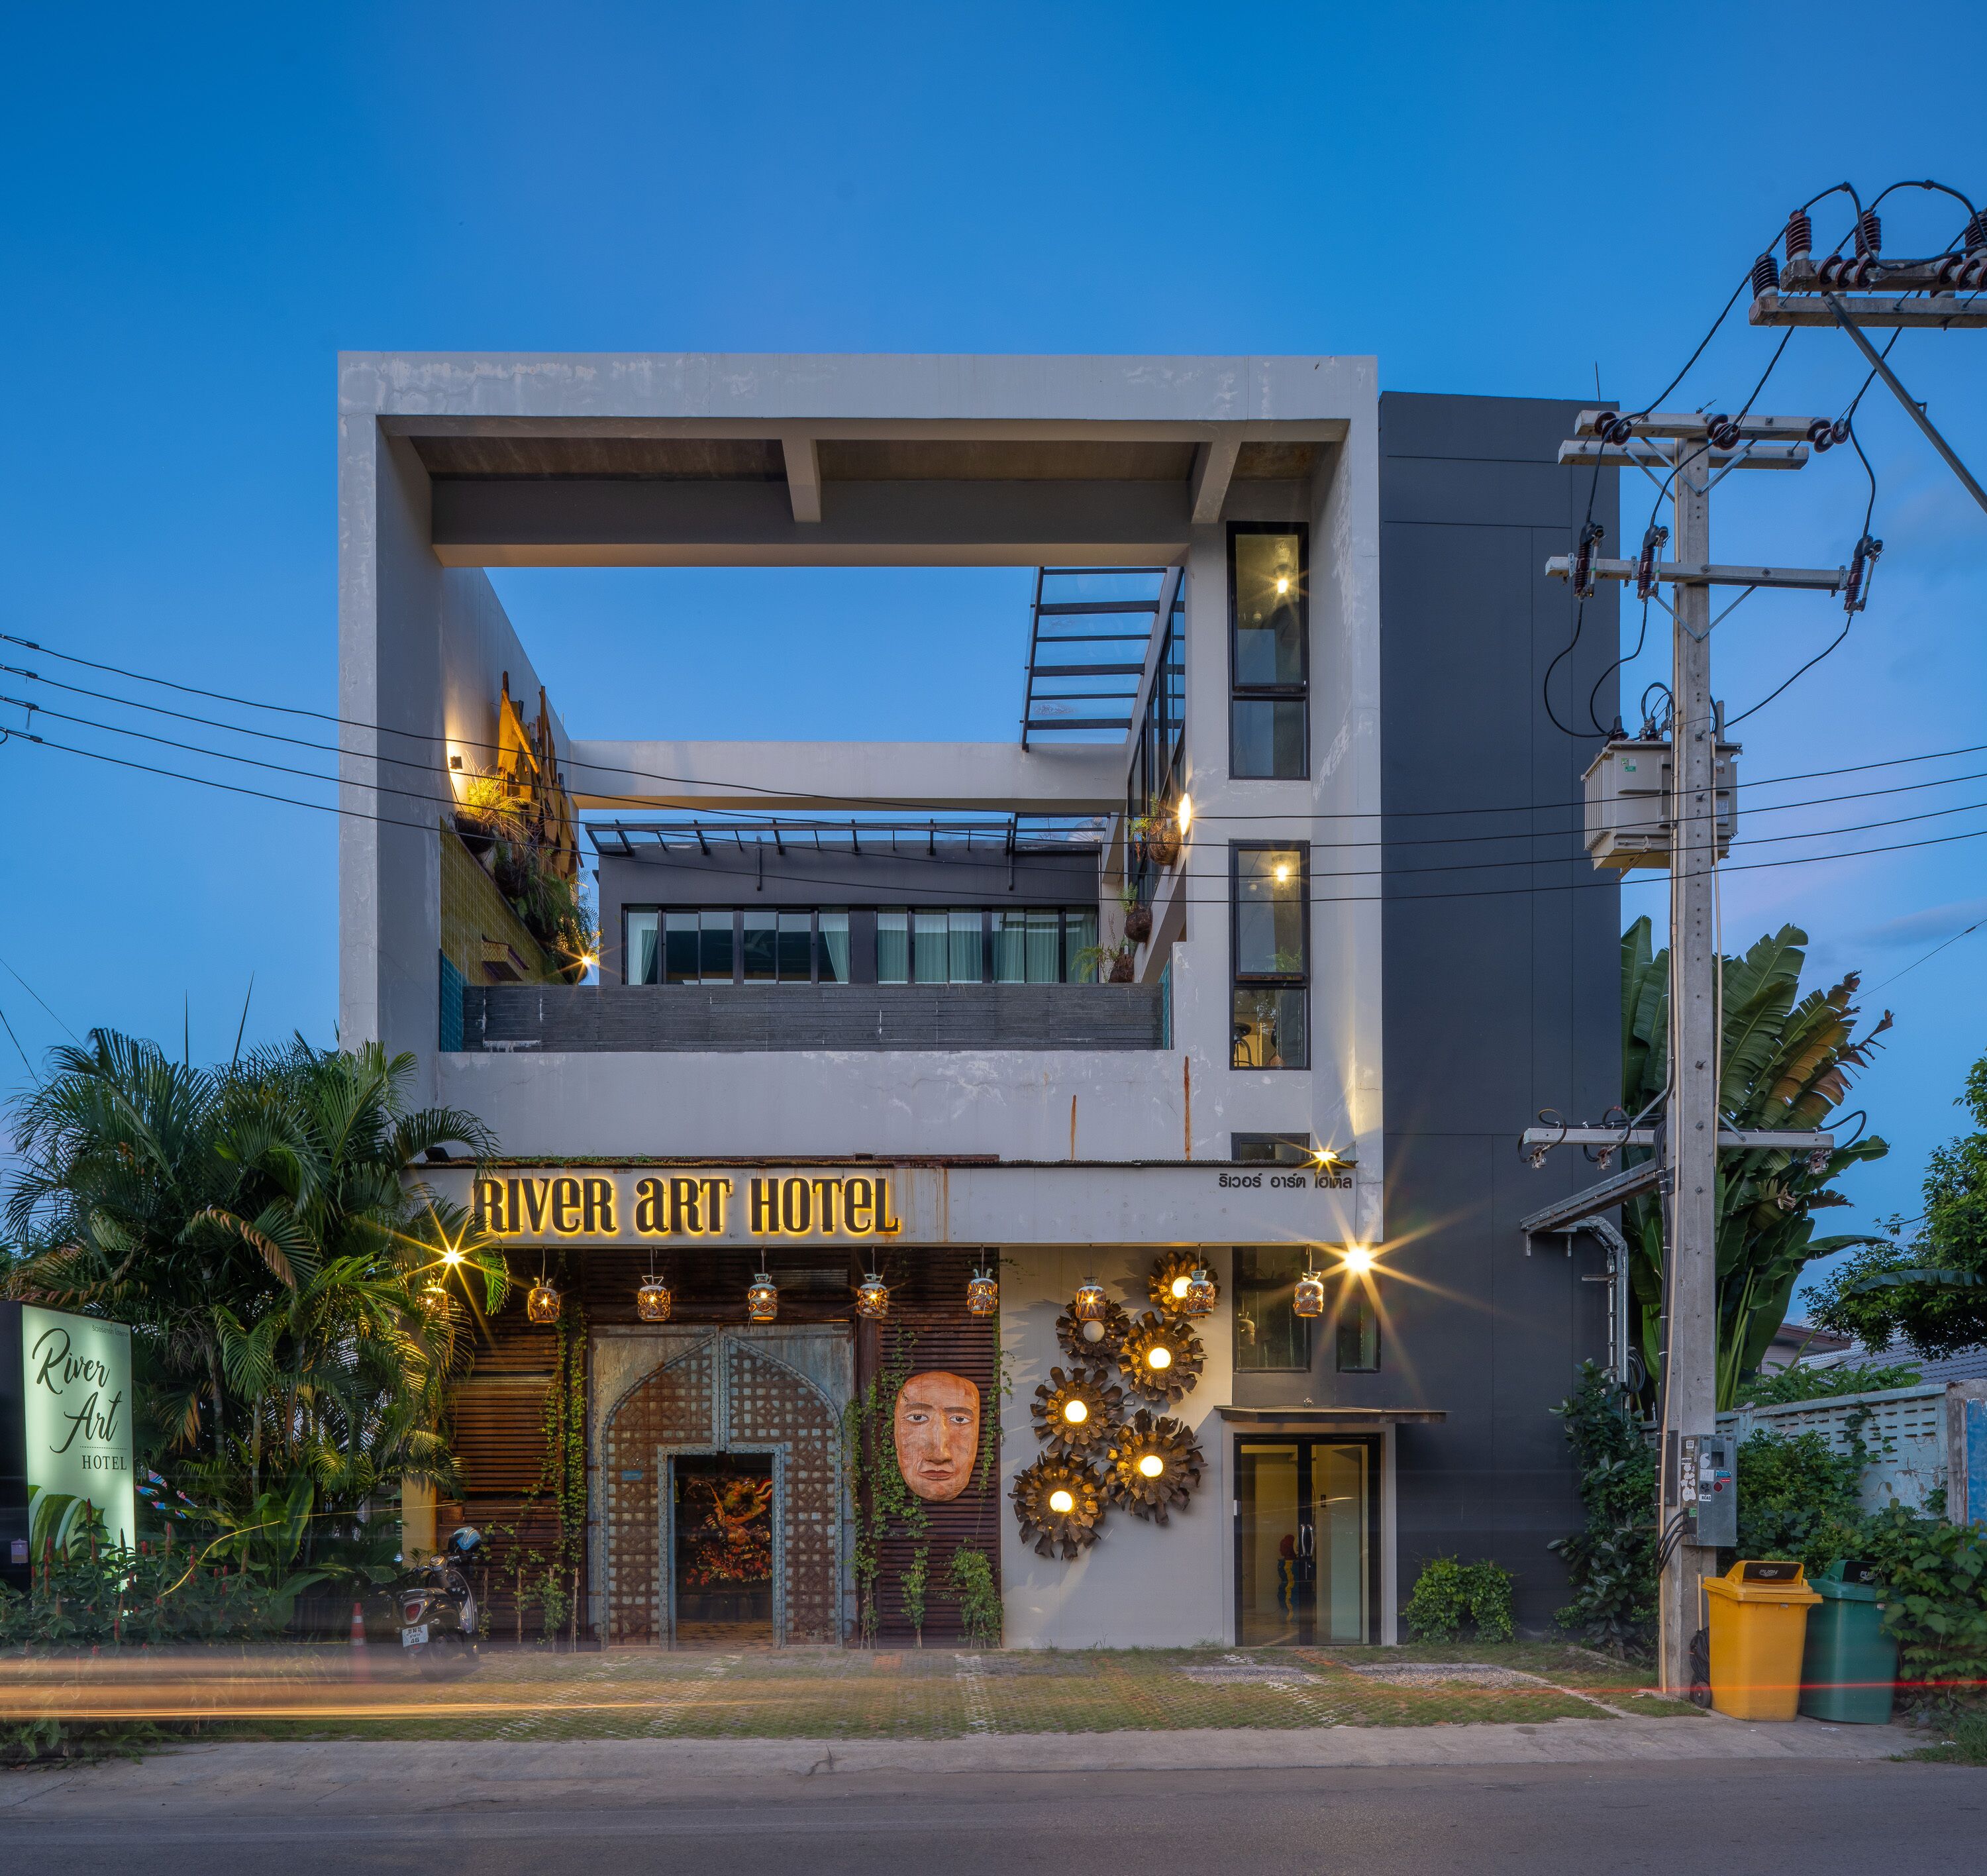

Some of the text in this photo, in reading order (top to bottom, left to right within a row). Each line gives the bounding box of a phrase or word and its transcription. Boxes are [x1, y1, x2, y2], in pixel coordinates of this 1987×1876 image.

[1218, 1172, 1262, 1188] ริเวอร์
[1270, 1173, 1305, 1188] อาร์ต
[32, 1328, 110, 1395] River
[49, 1390, 122, 1454] Art
[81, 1454, 127, 1471] HOTEL
